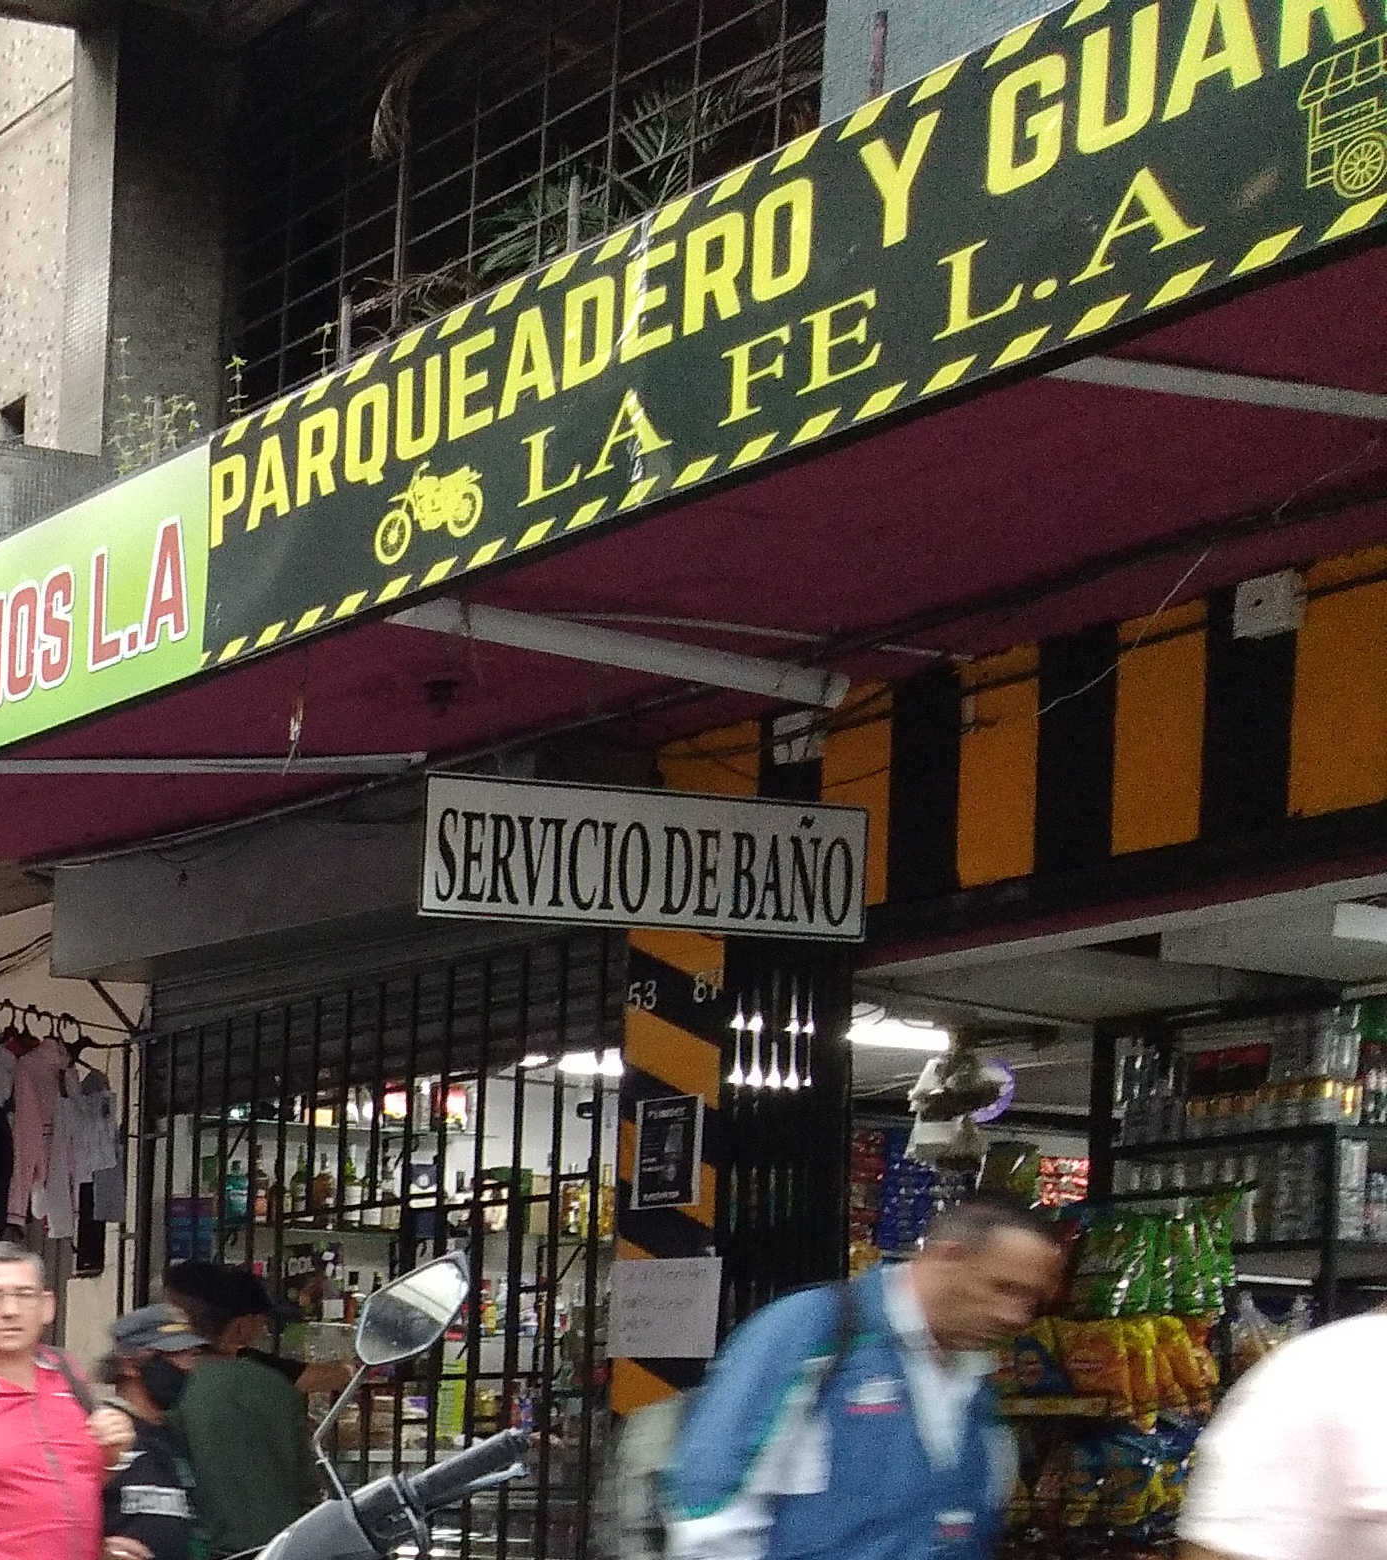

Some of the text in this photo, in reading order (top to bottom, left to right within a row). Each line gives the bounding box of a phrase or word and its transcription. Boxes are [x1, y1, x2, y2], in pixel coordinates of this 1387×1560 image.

[210, 0, 1387, 548] PARQUEADERO Y GUAR
[518, 166, 1206, 507] LA FE L.A
[90, 518, 189, 668] L.A
[434, 806, 853, 928] SERVICIO DE BAÑO
[627, 980, 658, 1012] 53
